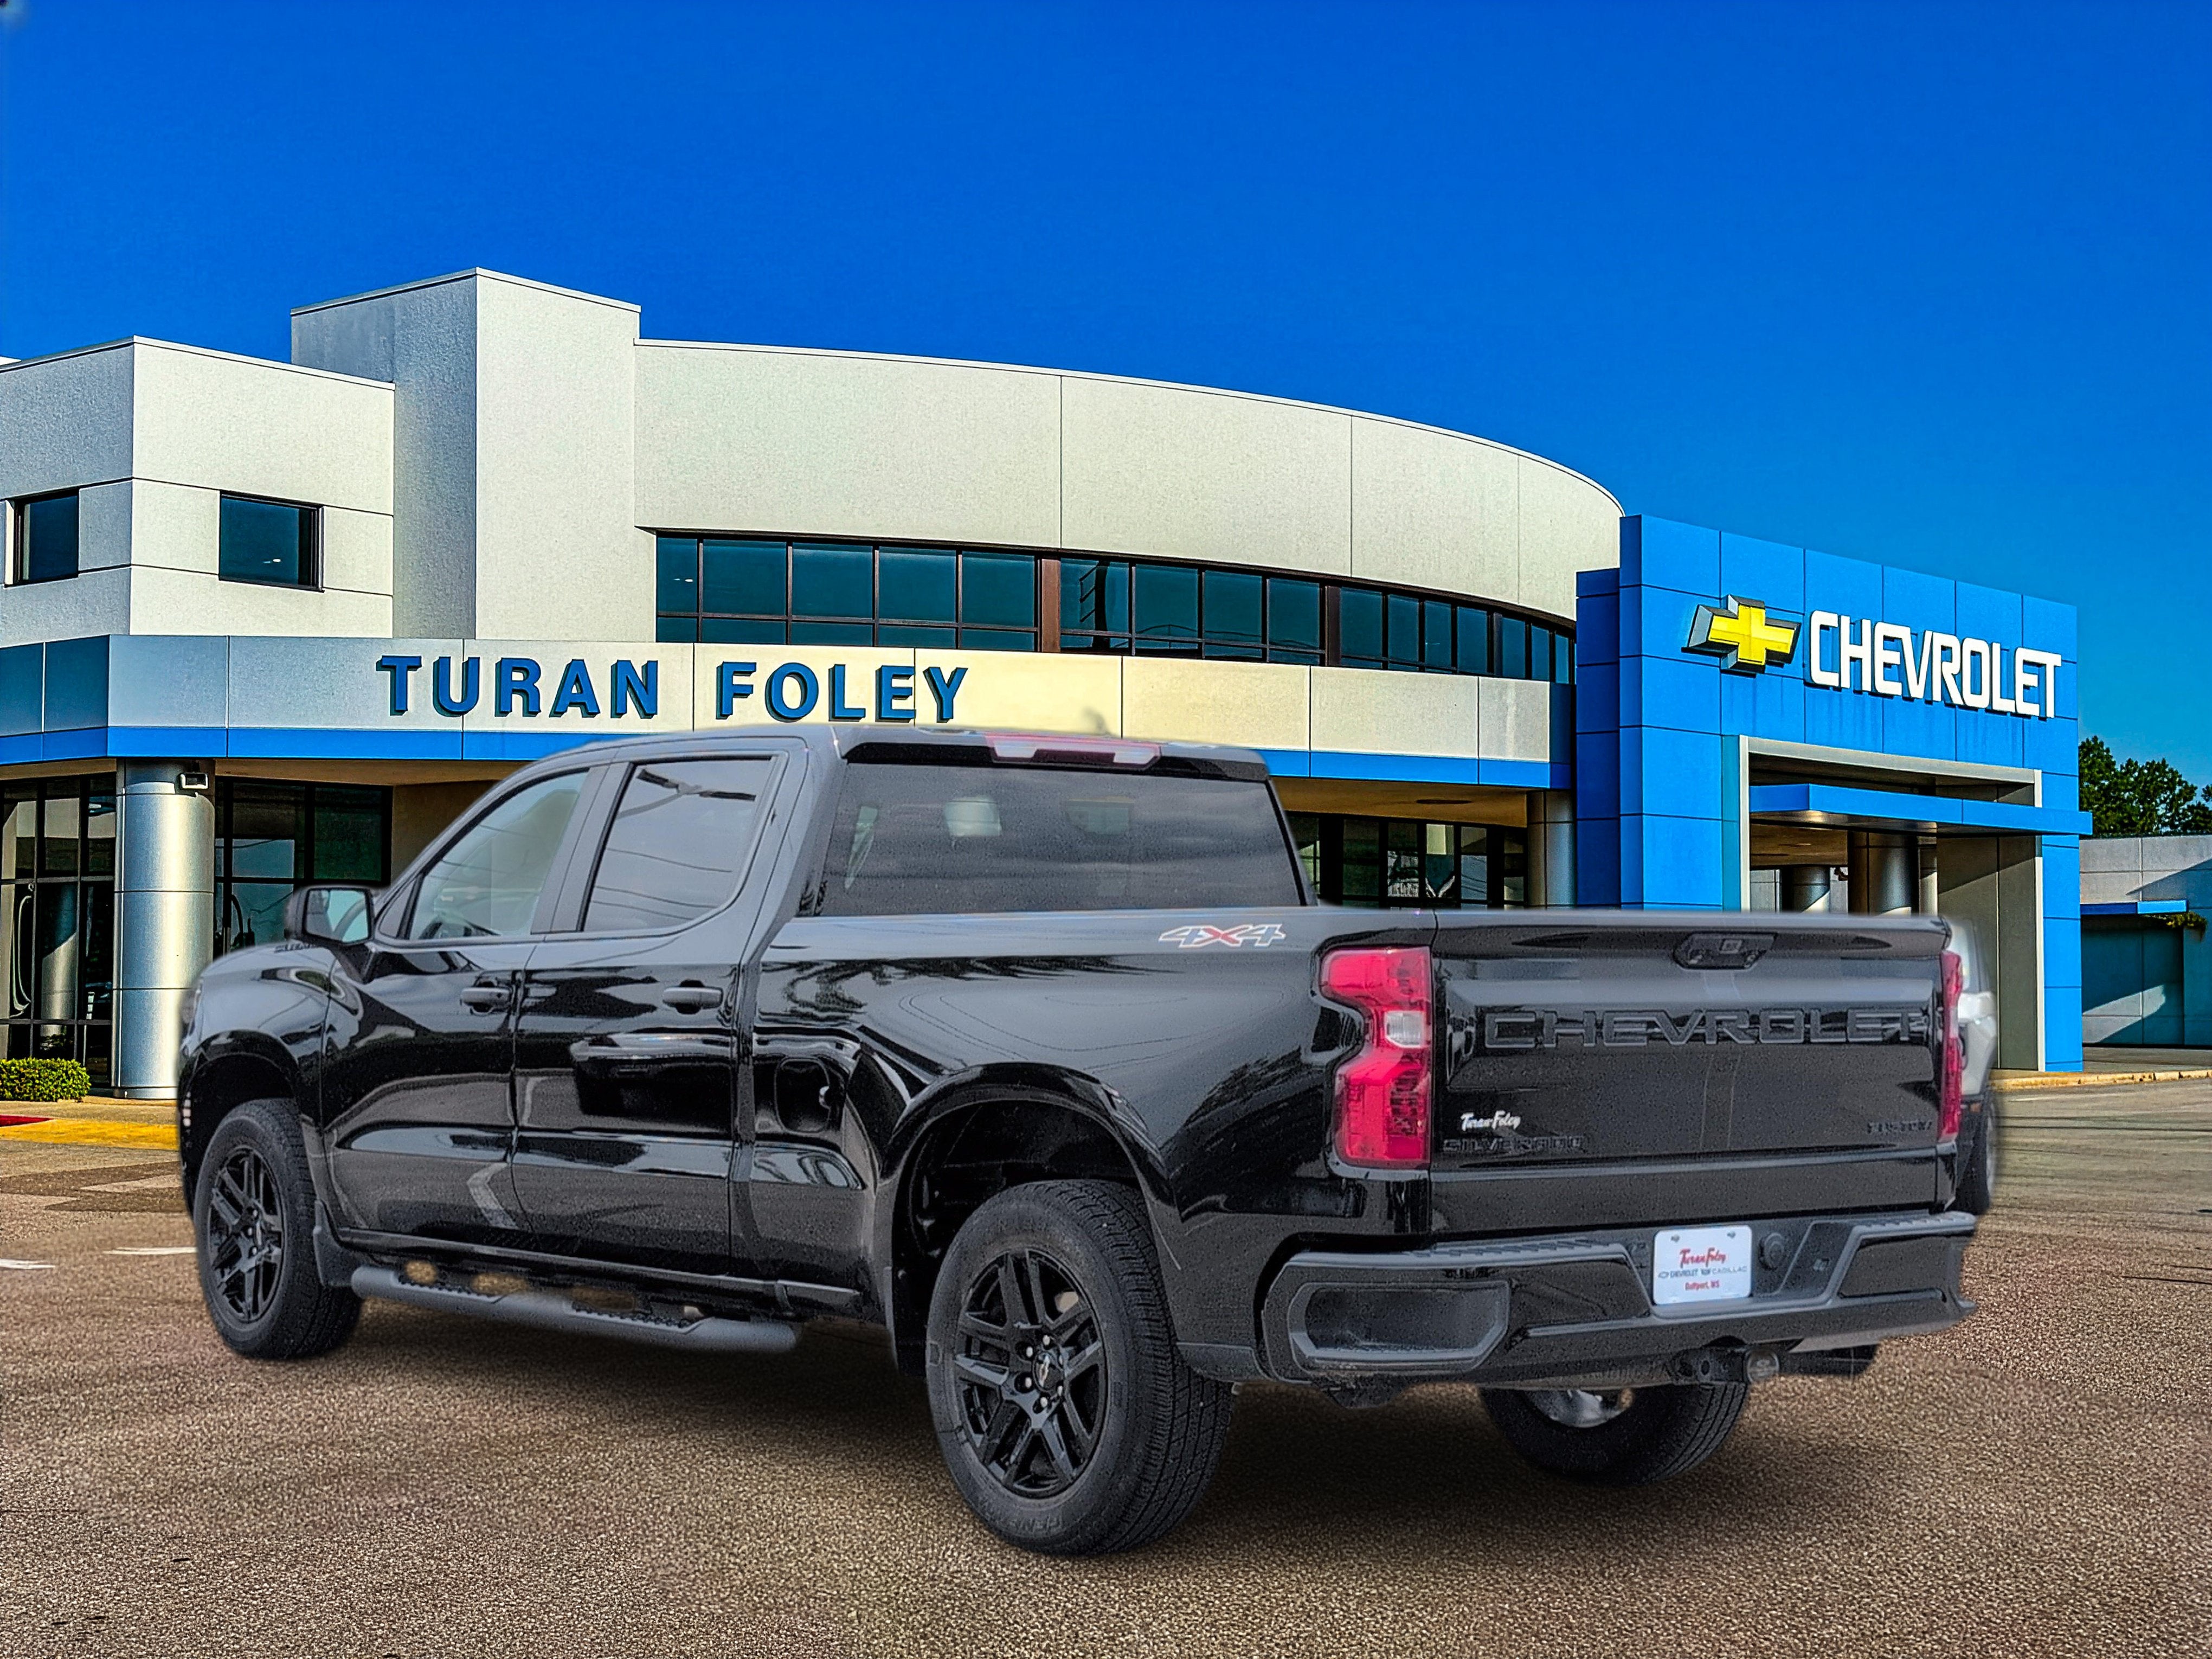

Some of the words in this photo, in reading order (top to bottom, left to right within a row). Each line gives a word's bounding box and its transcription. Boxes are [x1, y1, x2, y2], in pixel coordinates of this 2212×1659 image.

[376, 655, 658, 718] TURAN
[716, 661, 968, 722] FOLEY
[1808, 609, 2062, 719] CHEVROLET
[1484, 1008, 1925, 1048] CHEVROLET
